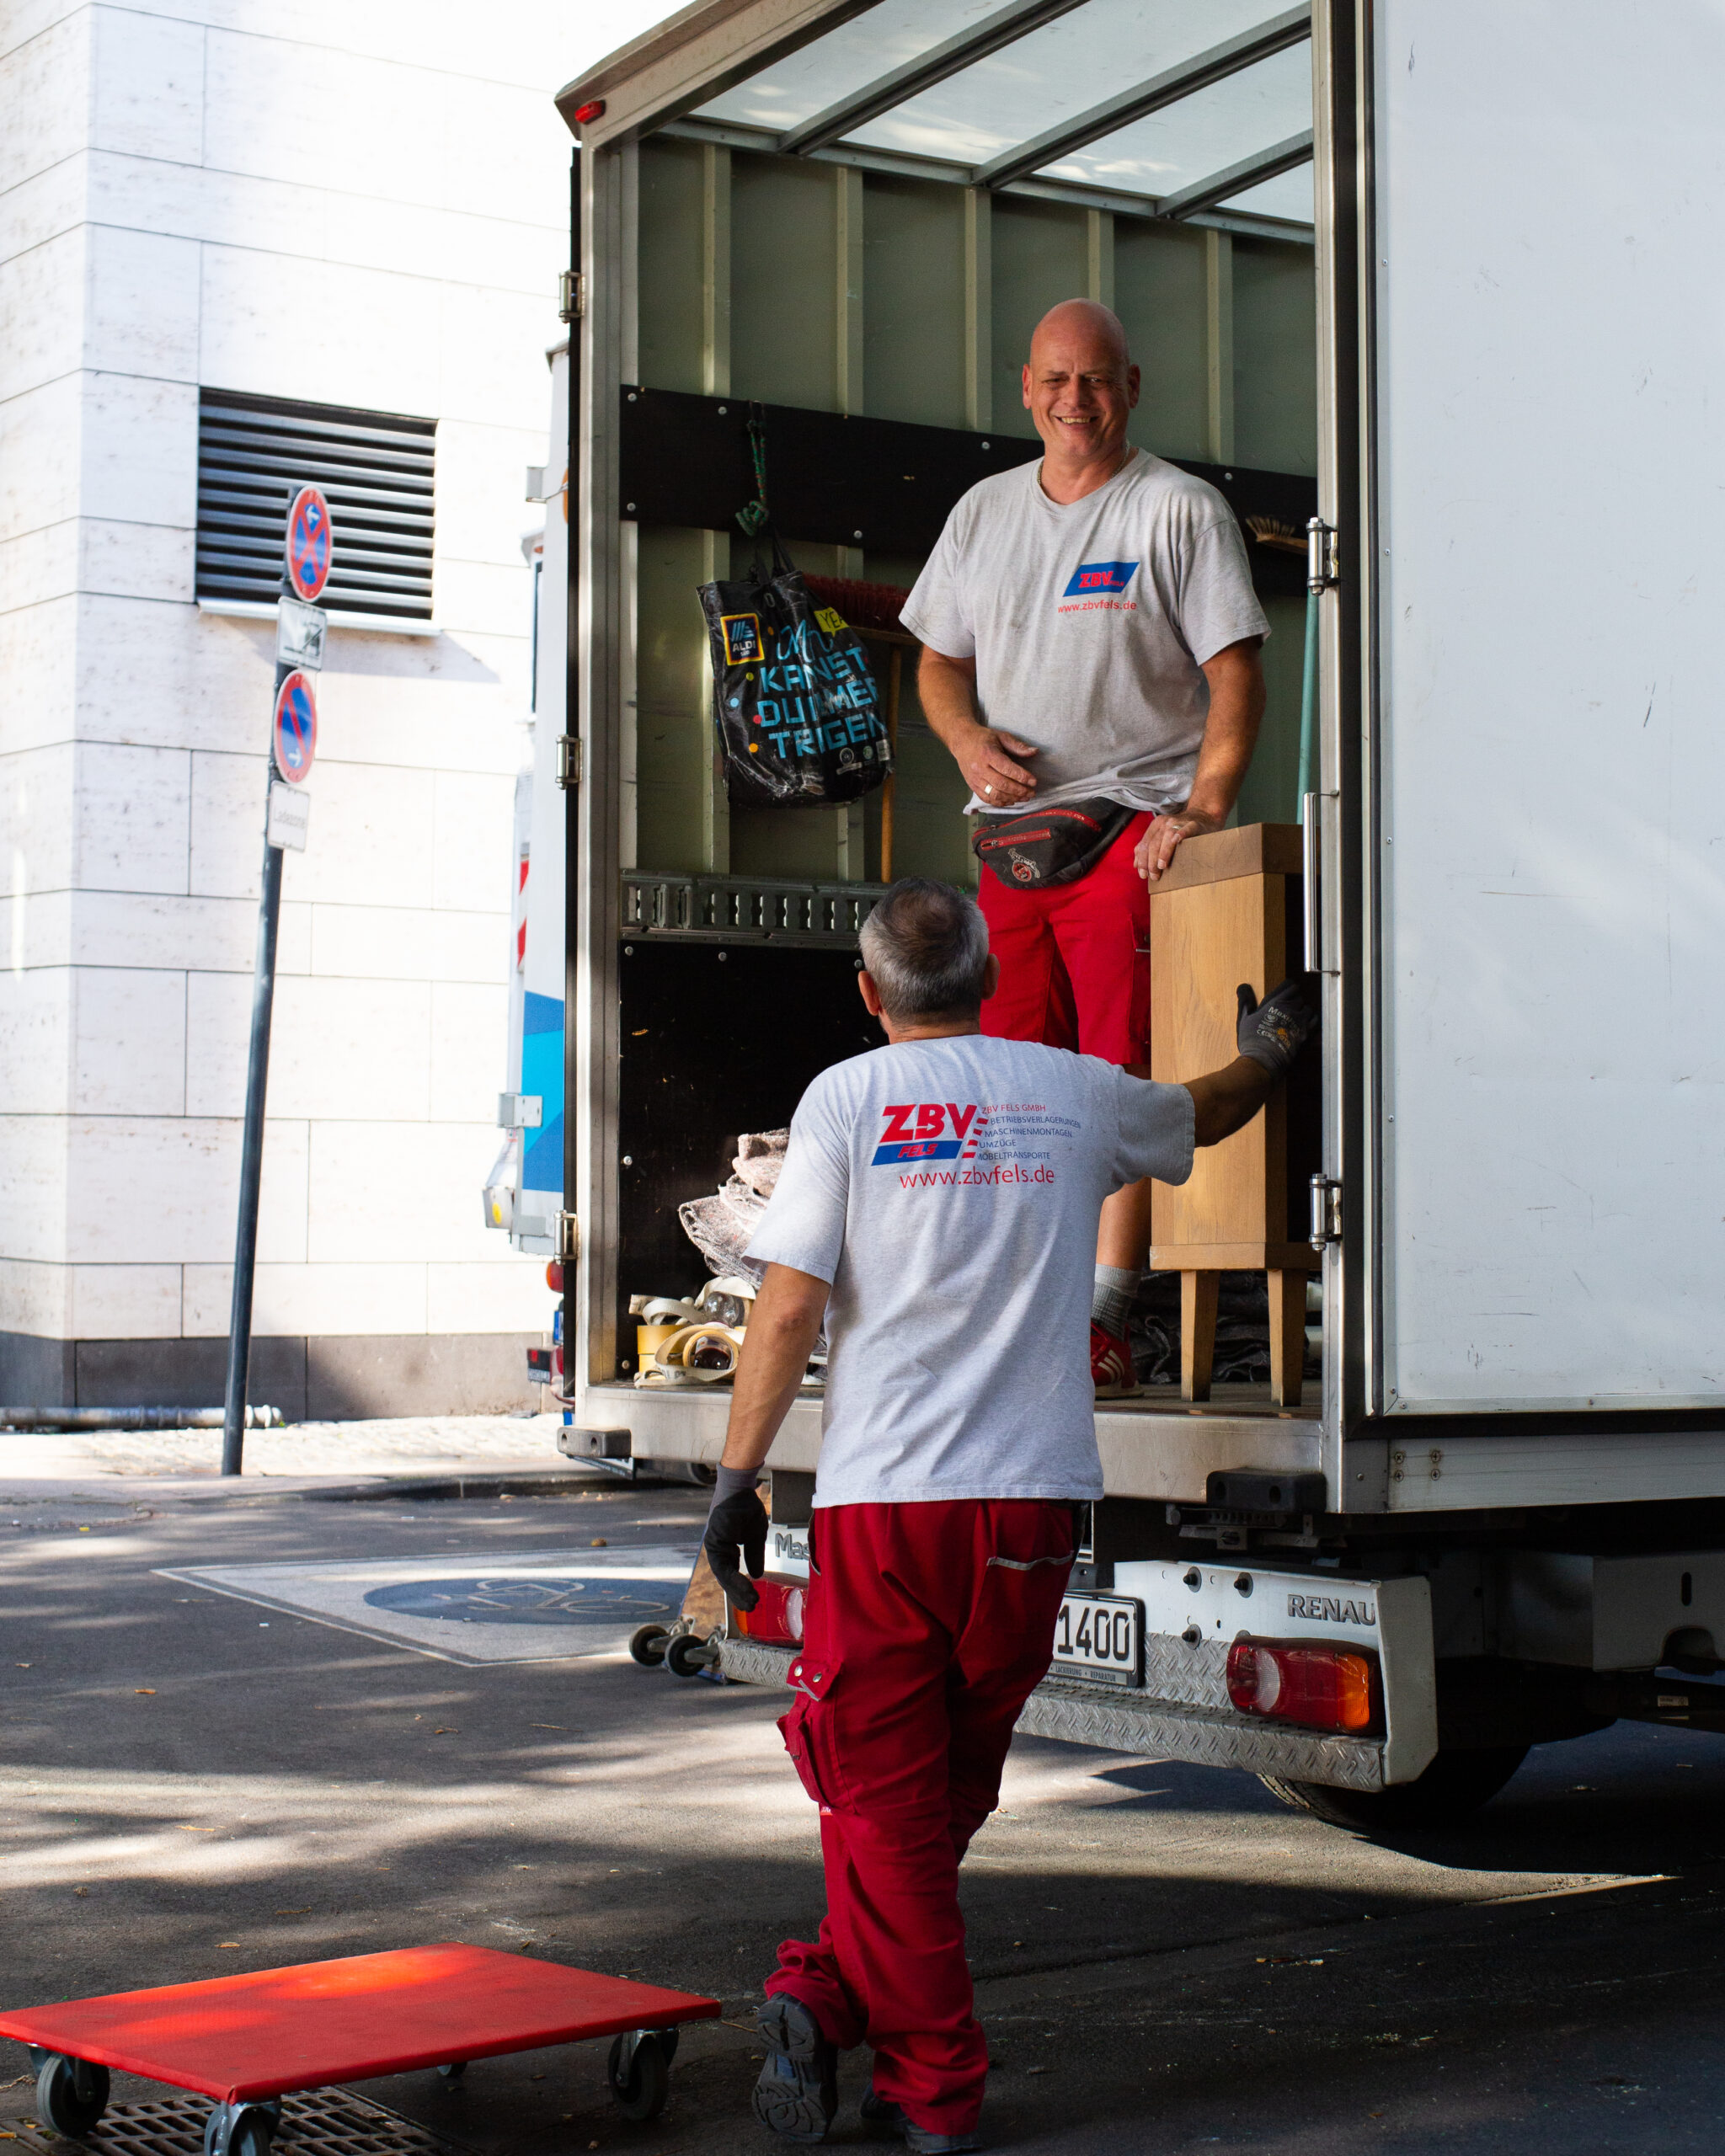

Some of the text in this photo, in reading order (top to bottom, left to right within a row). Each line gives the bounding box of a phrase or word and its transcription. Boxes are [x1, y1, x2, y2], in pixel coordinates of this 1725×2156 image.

[1078, 570, 1114, 588] ZBV
[1058, 599, 1137, 613] www.zbvfels.de
[732, 640, 756, 652] ALDI
[757, 696, 806, 728] DU
[981, 1105, 998, 1114] ZBV
[1022, 1103, 1046, 1113] GMBH
[879, 1102, 978, 1144] ZBV
[985, 1128, 1072, 1138] MASCHINENMONTAGEN
[897, 1143, 938, 1158] FELS
[979, 1139, 1017, 1149] UMZÜGE
[977, 1151, 1050, 1161] MÖBELTRANSPORTE
[900, 1164, 1055, 1188] www.zbvfels.de
[1287, 1593, 1376, 1626] RENAU
[1058, 1604, 1130, 1661] 1400
